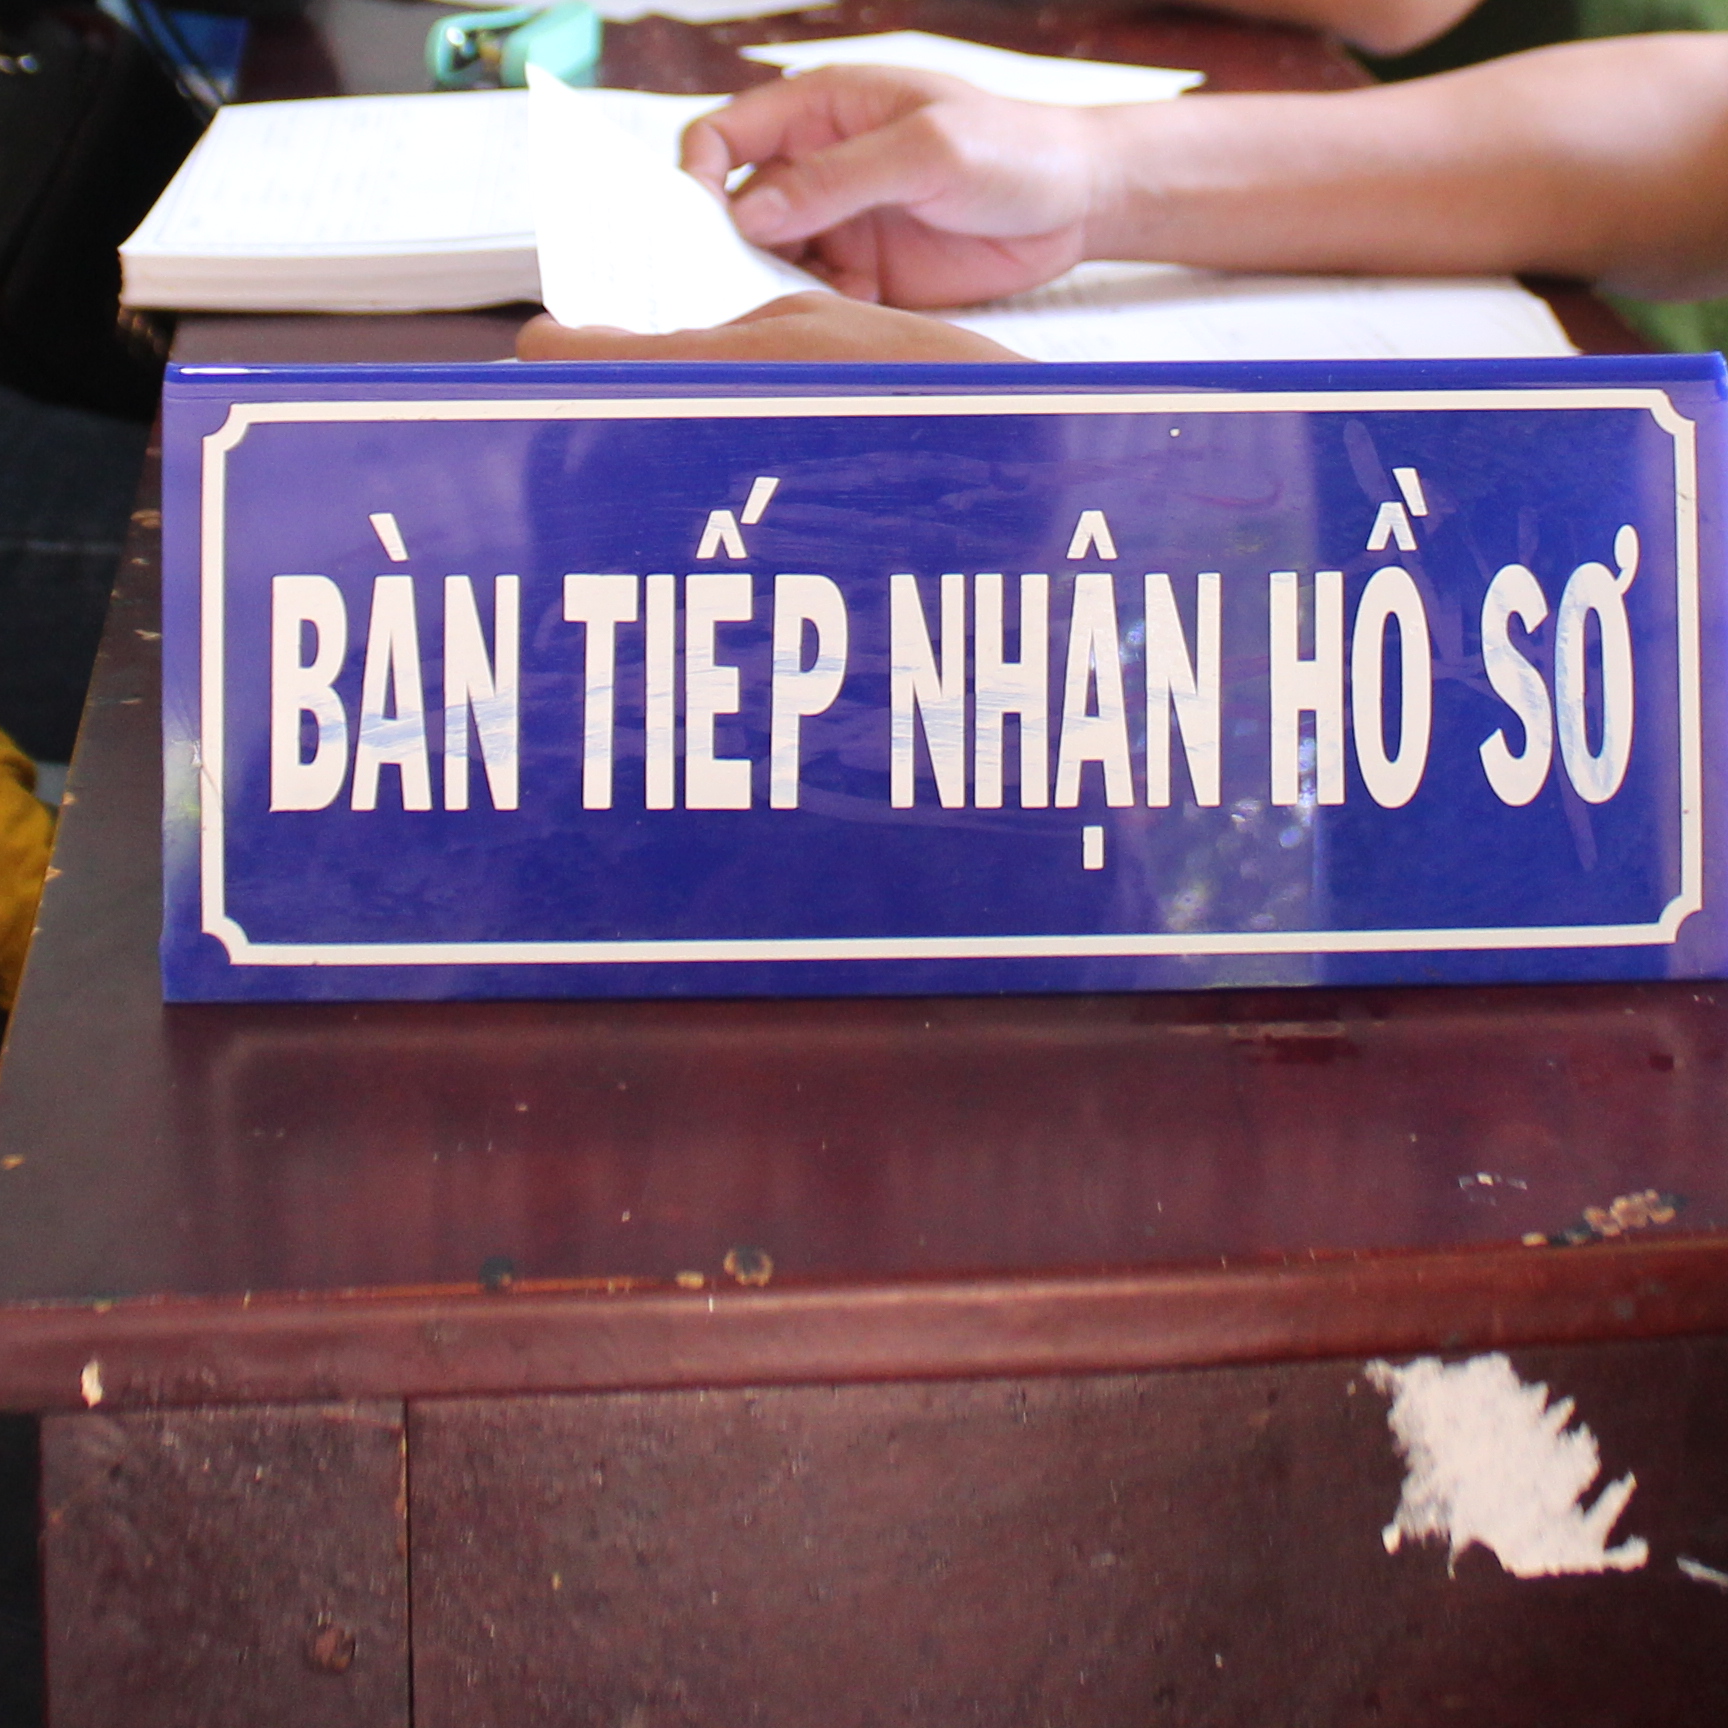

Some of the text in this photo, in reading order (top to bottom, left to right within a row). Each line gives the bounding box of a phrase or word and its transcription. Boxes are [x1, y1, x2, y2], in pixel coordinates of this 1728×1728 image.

[269, 467, 1639, 870] BÀN TIẾP NHẬN HỒ SƠ
